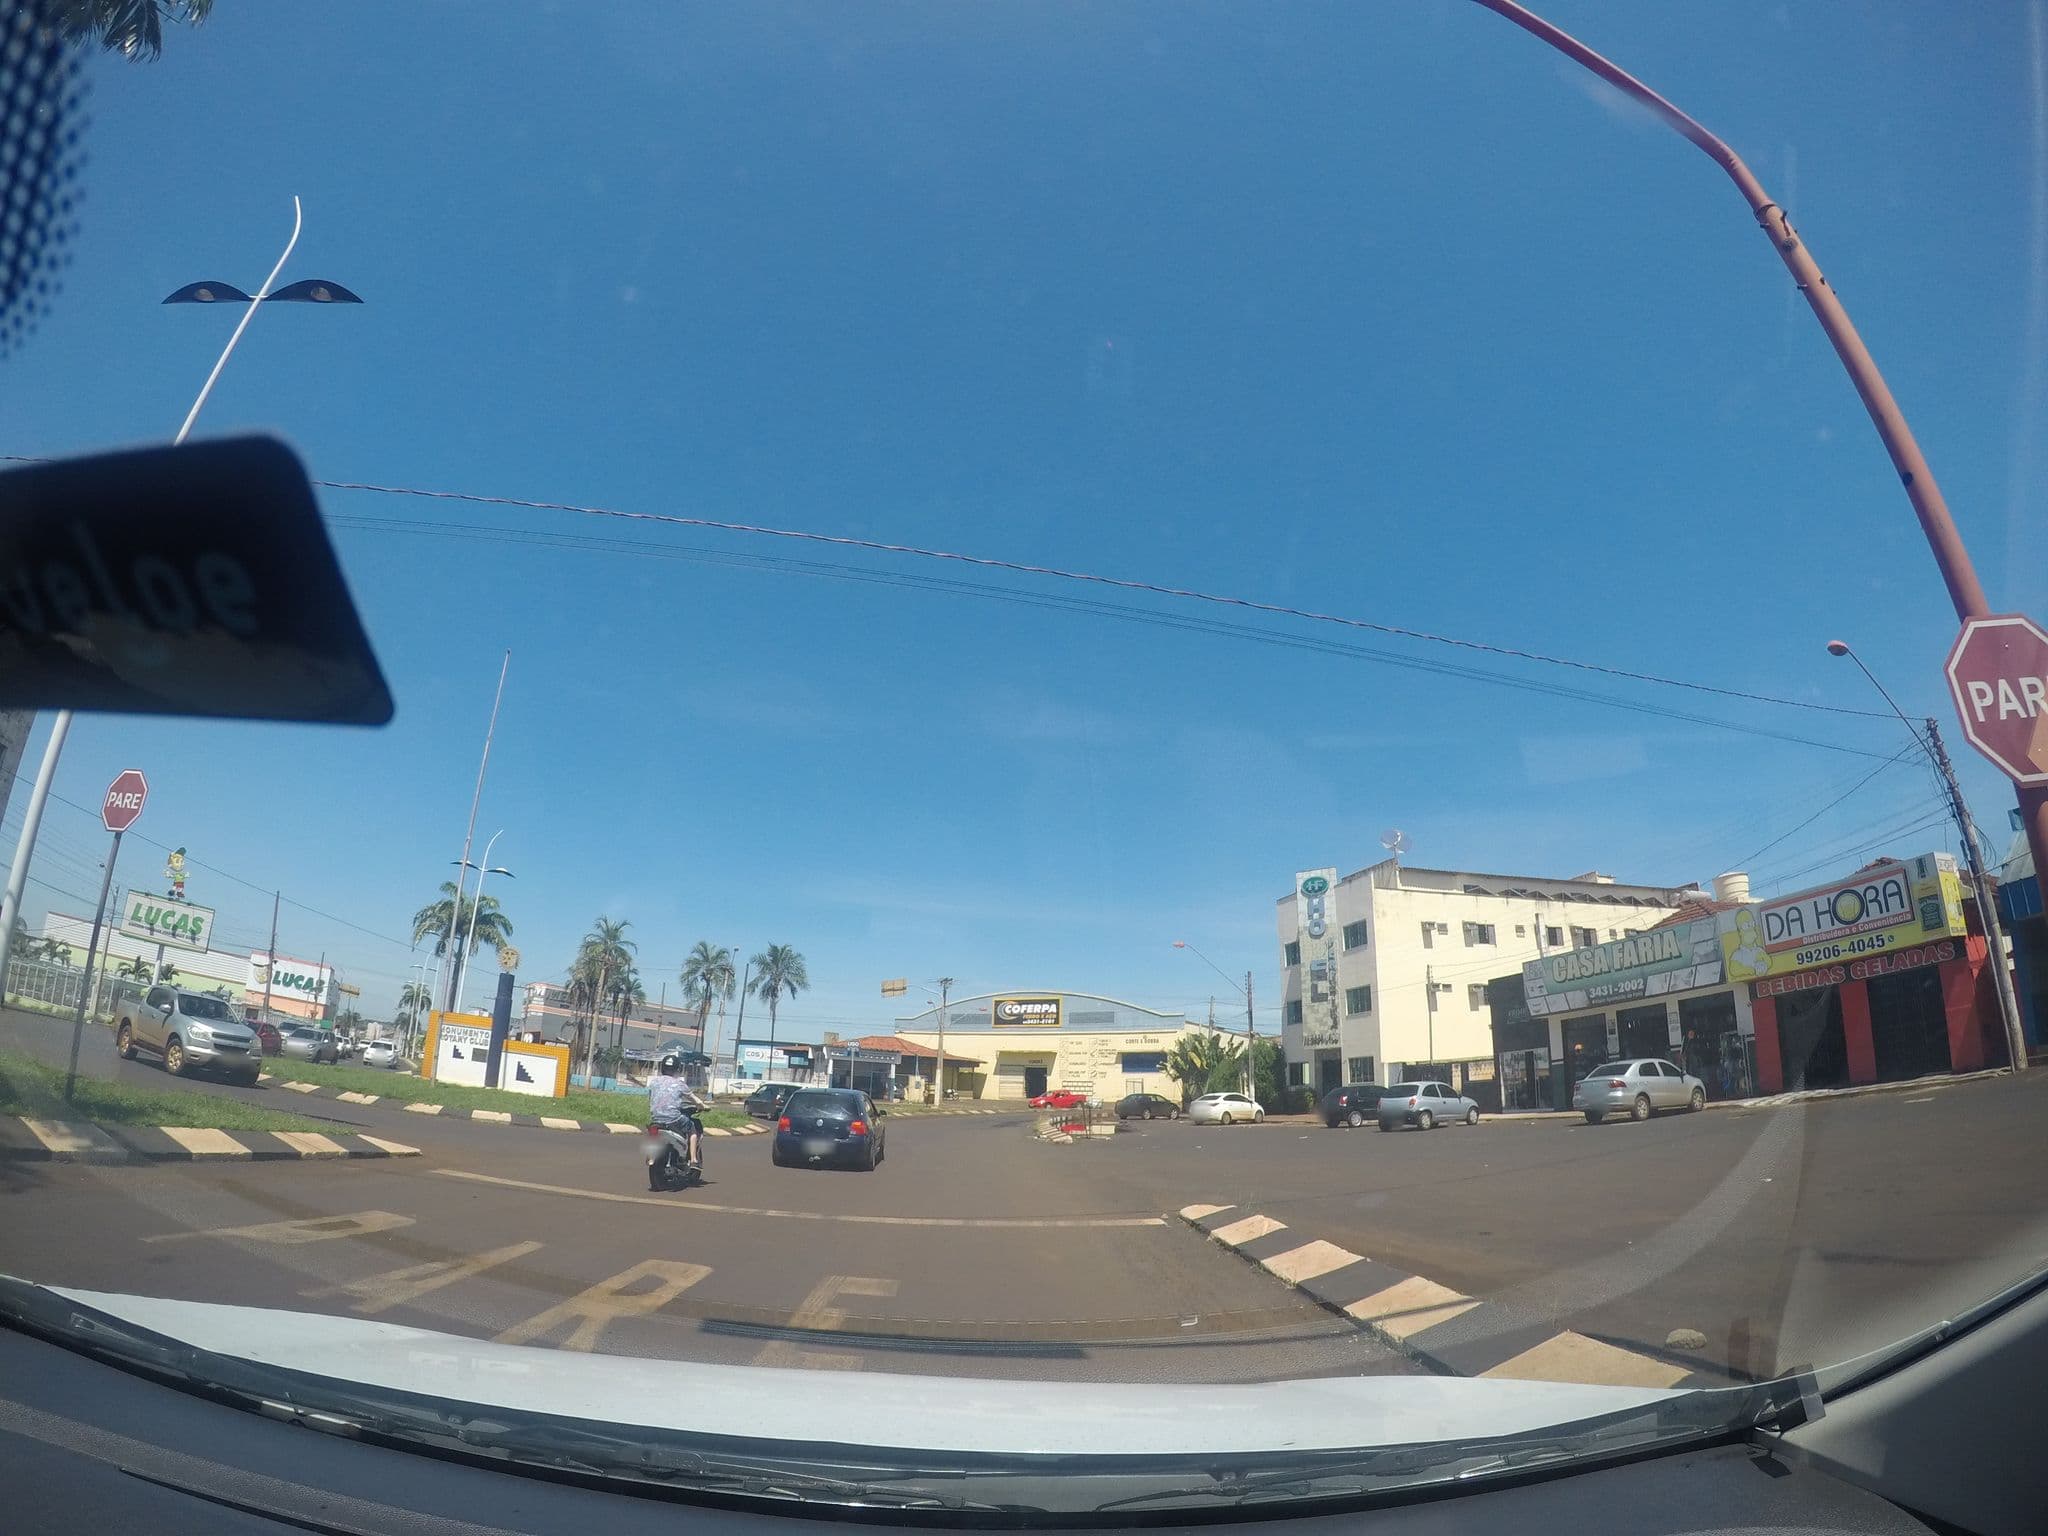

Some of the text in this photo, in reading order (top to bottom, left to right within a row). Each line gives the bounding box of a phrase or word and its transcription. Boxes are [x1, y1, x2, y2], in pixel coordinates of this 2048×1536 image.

[106, 791, 142, 810] PARE
[130, 902, 205, 935] LUCAS
[1764, 906, 1806, 942] DA
[1813, 879, 1905, 929] HORA
[1552, 929, 1682, 983] CASA FARIA
[1796, 933, 1886, 965] 99206-4045
[272, 970, 325, 993] LUCAS
[1756, 941, 1955, 998] BEBIDAS GELADAS
[1589, 978, 1645, 999] 3431-2002
[1004, 1003, 1057, 1014] COFERPA
[440, 1033, 468, 1044] OTARY
[141, 1209, 901, 1369] PARE
